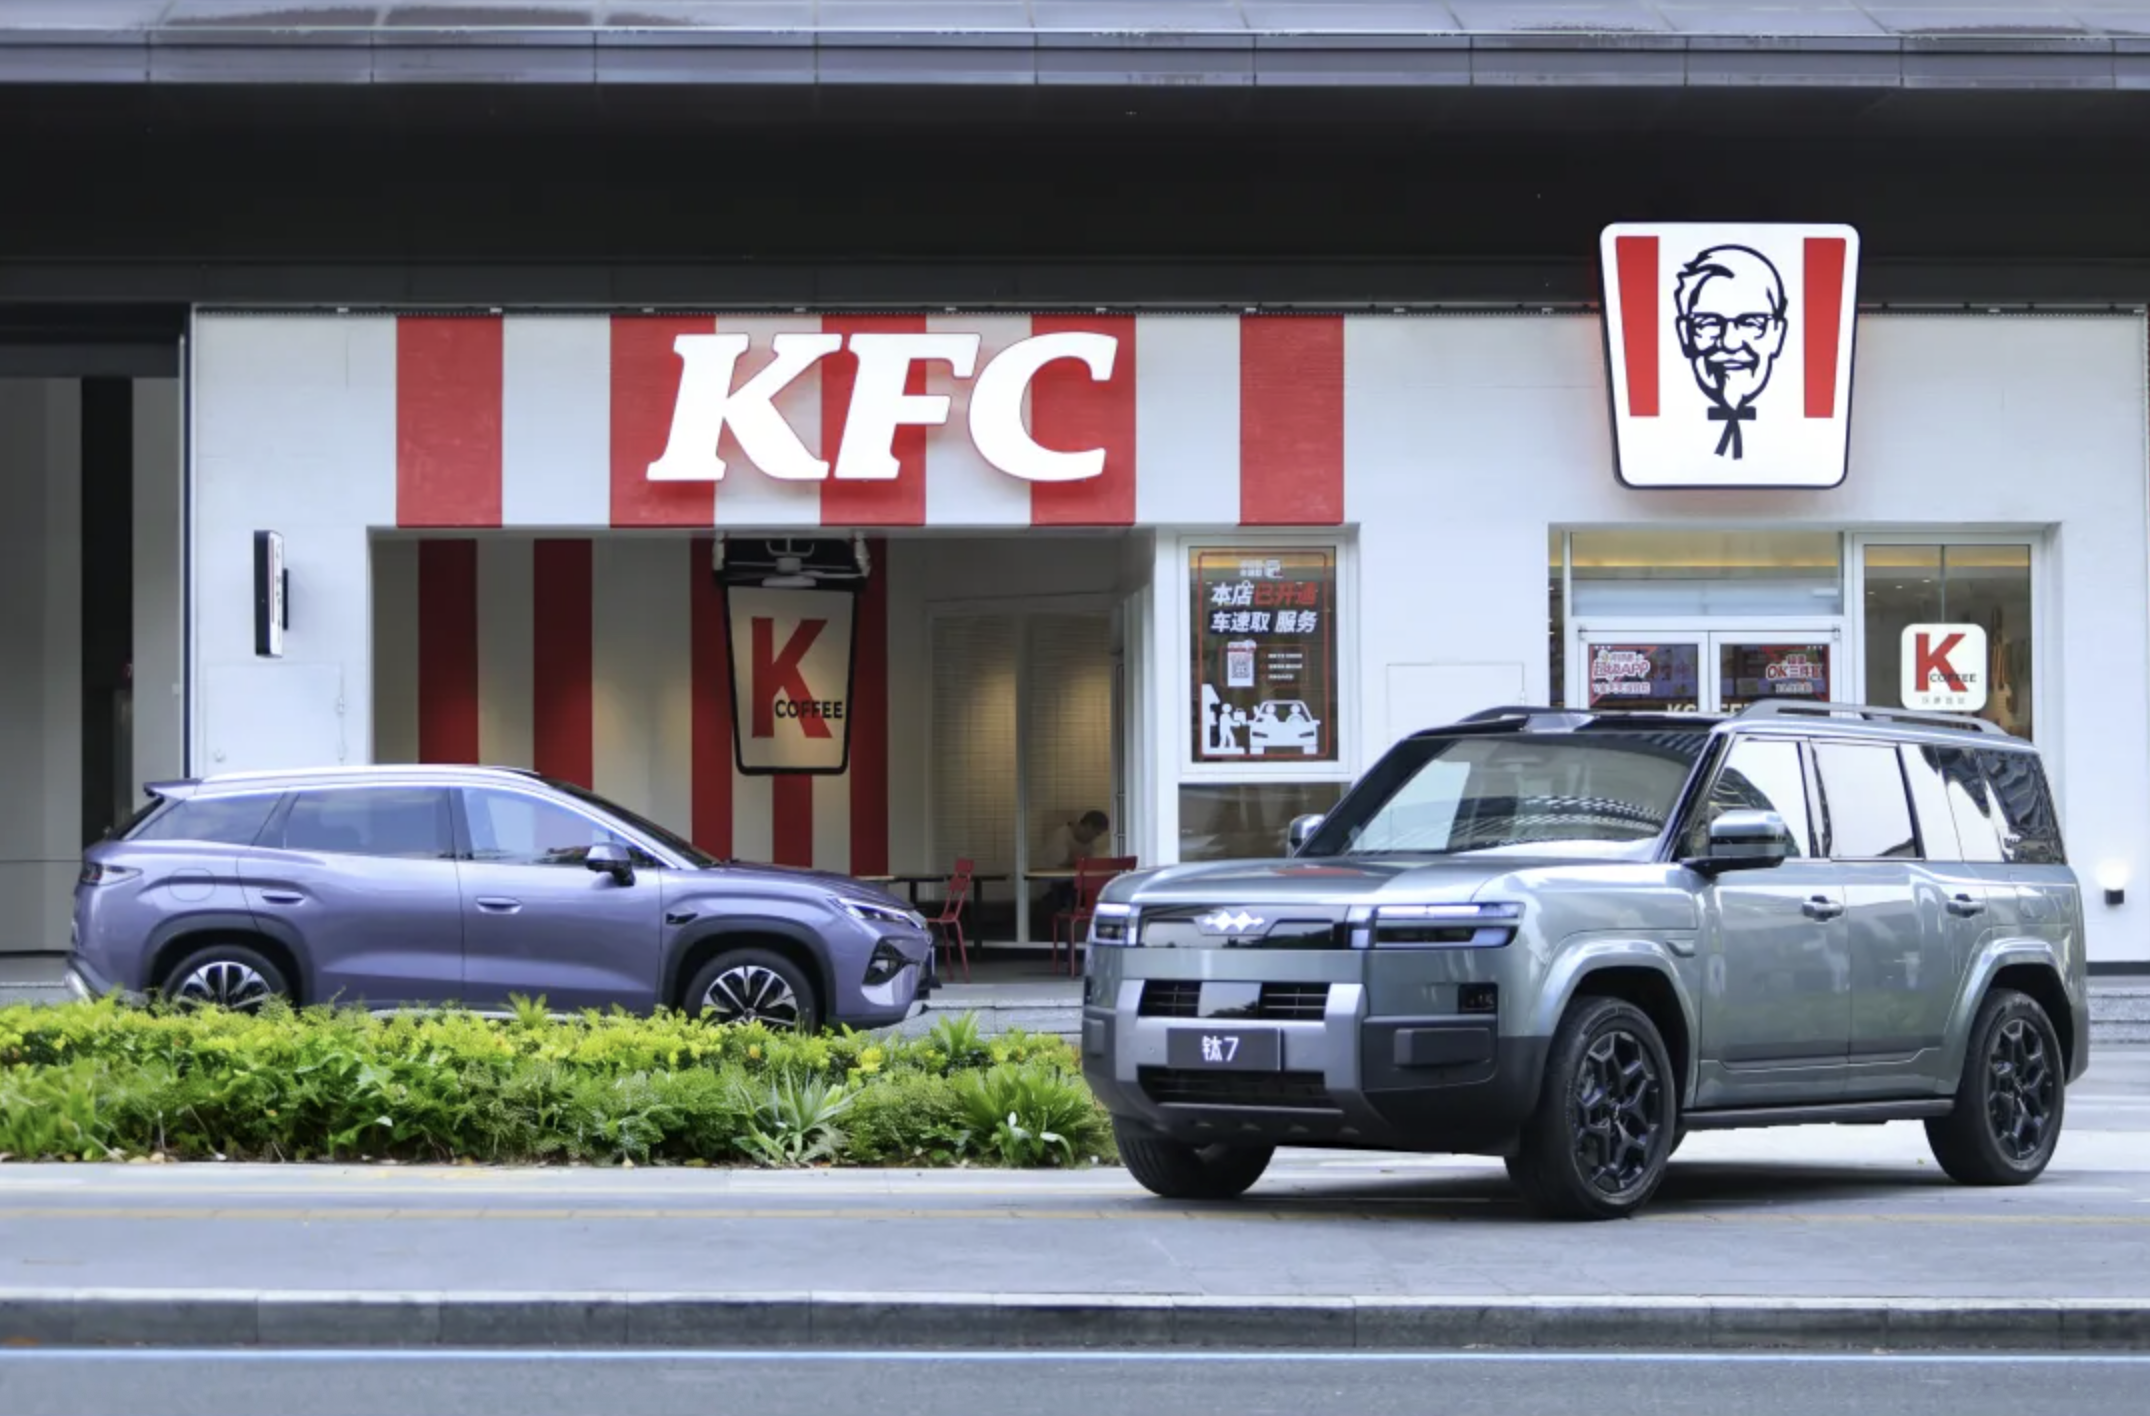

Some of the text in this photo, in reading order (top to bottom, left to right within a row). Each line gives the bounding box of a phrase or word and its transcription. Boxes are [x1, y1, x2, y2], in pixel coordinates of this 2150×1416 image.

[646, 331, 1118, 482] KFC
[1210, 610, 1317, 633] 车速取 服务
[1915, 633, 1967, 692] K
[752, 616, 832, 738] K
[1930, 673, 1976, 683] COFFEE
[775, 699, 843, 719] COFFEE
[1202, 1035, 1239, 1062] 钛7
